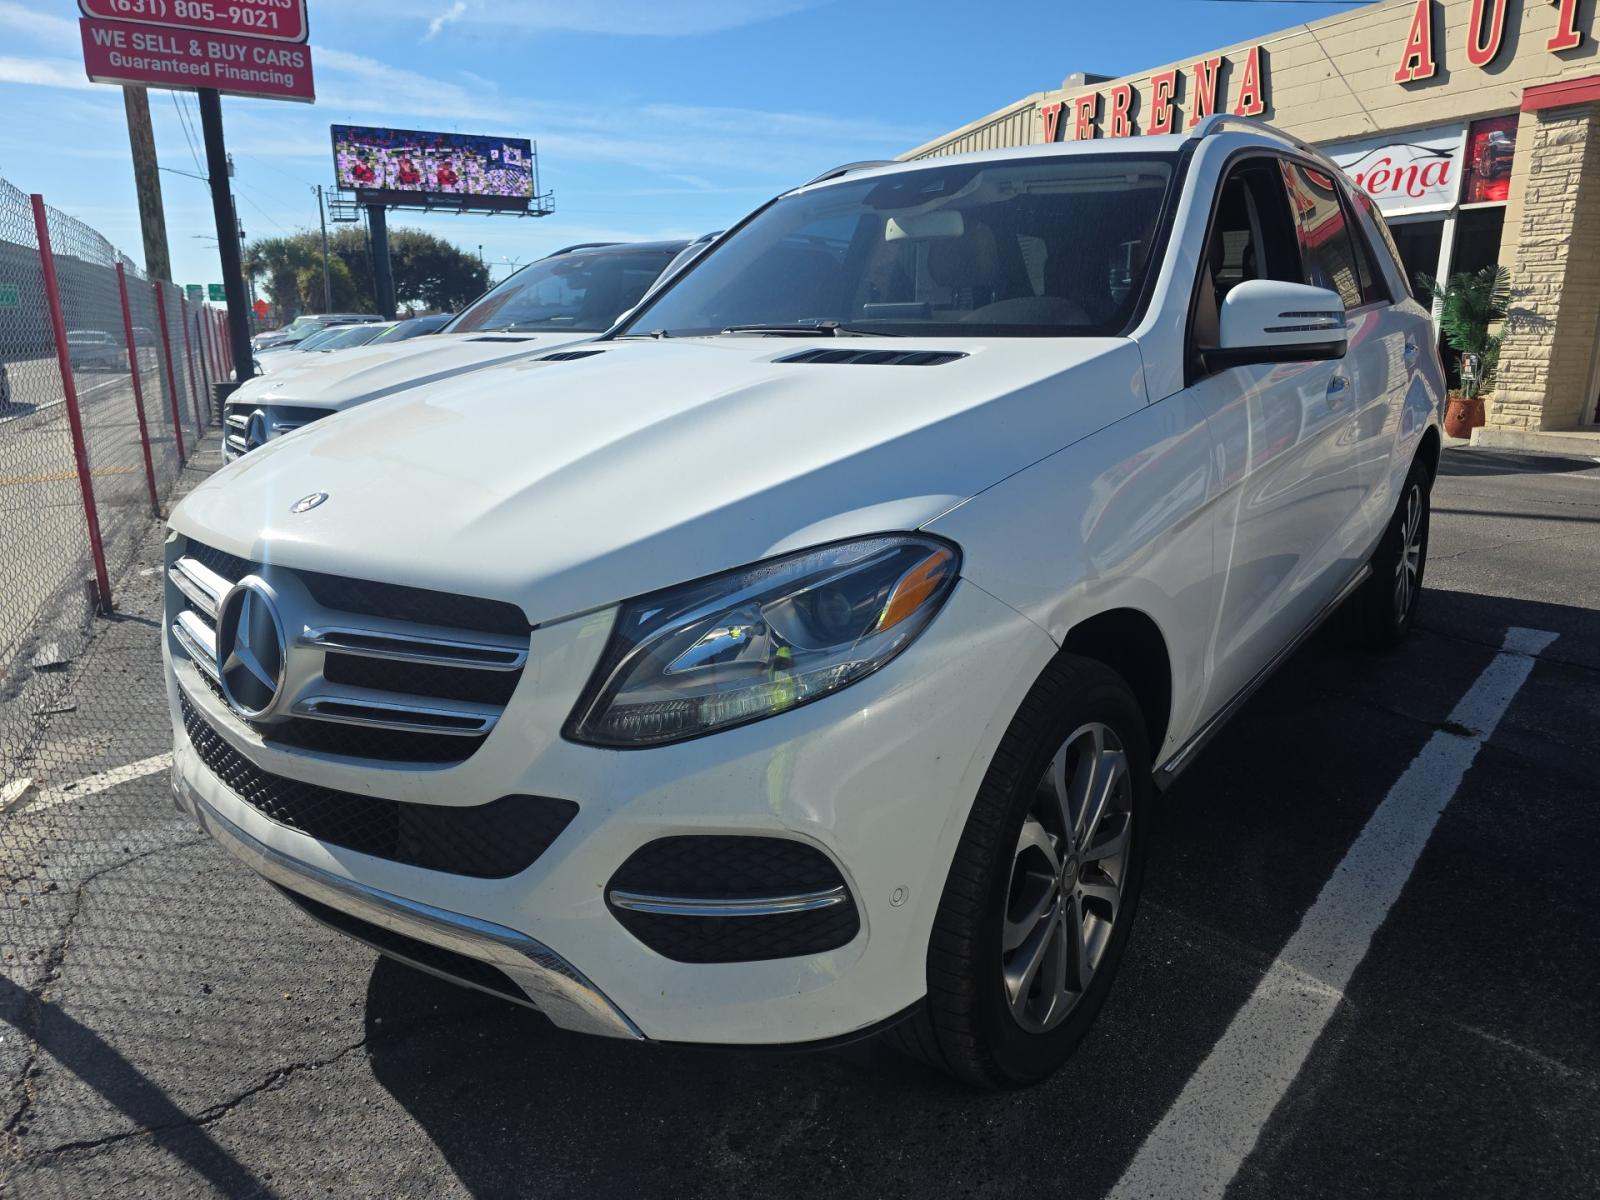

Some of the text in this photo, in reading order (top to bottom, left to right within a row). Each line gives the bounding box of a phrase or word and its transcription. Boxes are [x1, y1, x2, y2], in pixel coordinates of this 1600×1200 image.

[175, 1, 279, 29] 805-9021
[91, 28, 304, 68] WE SELL & BUY CARS
[109, 51, 294, 88] Guaranteed Financing
[1041, 46, 1264, 144] VERENA
